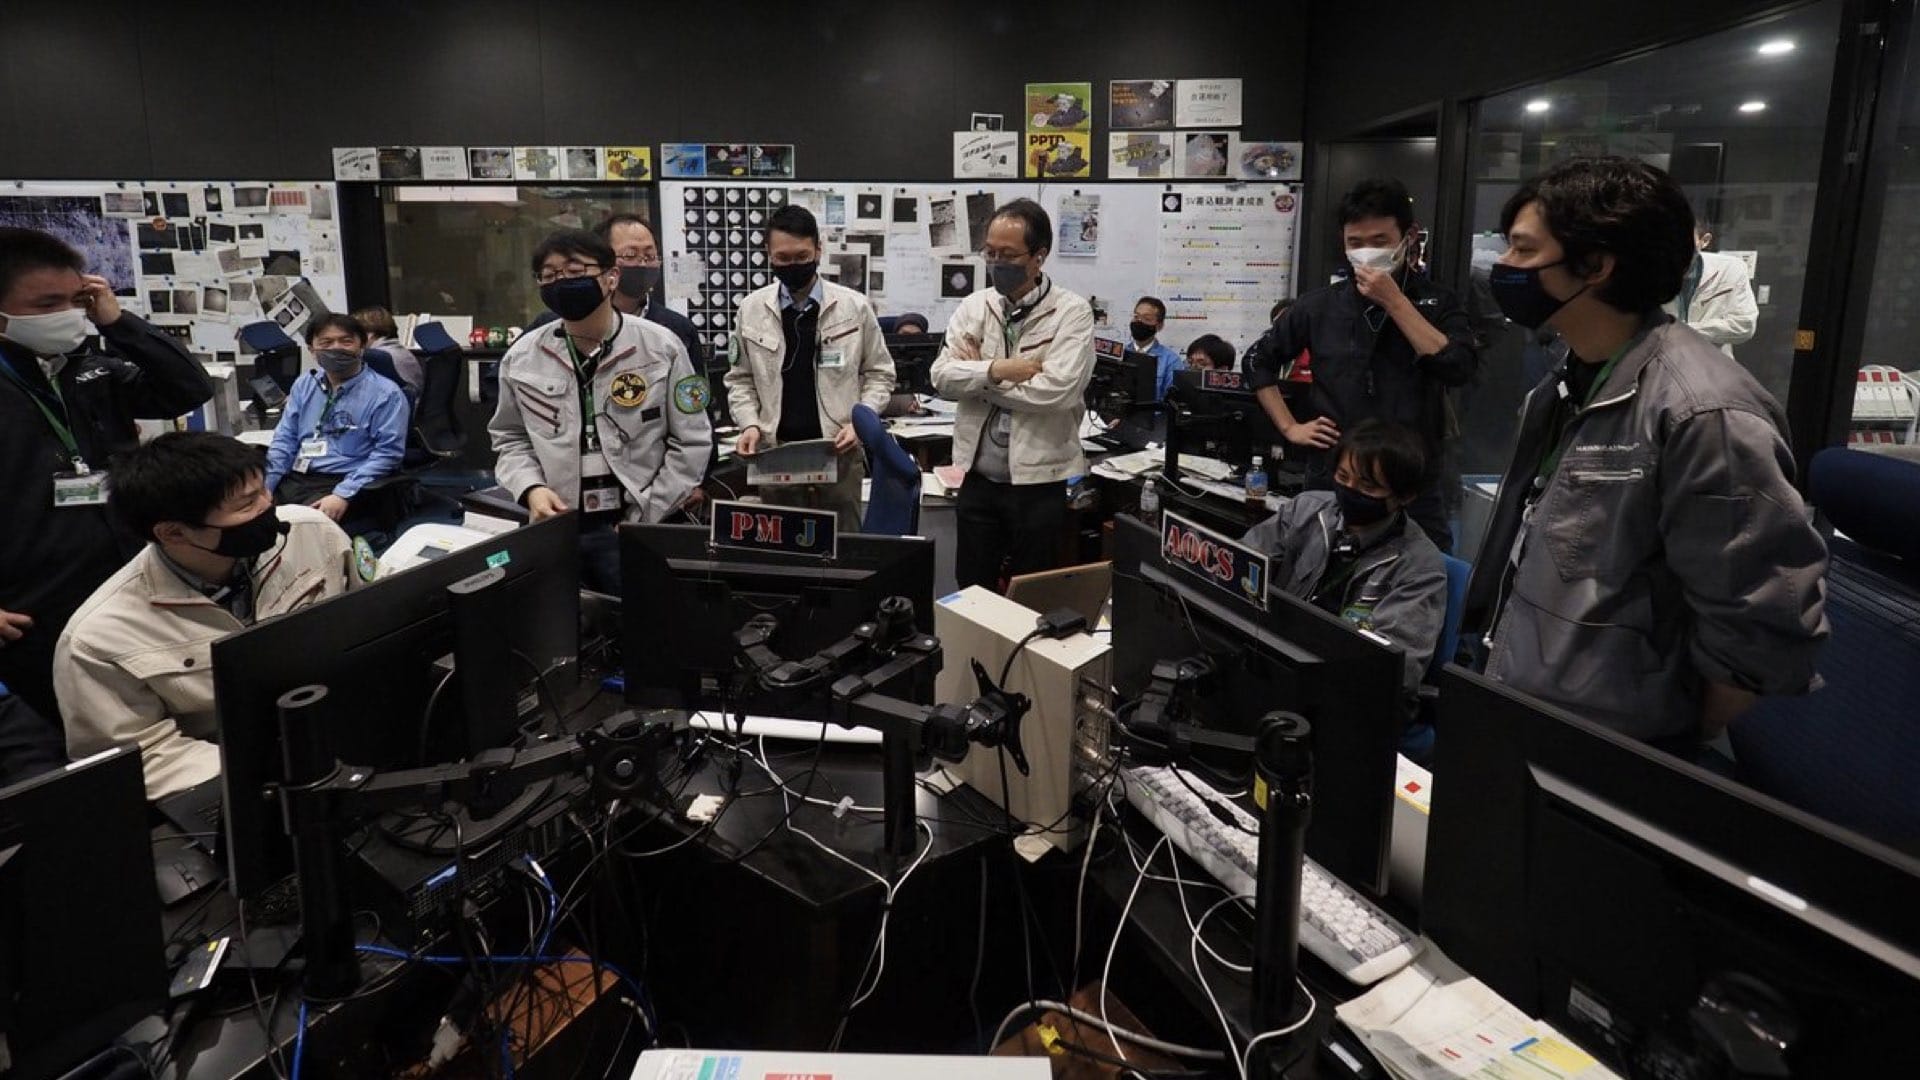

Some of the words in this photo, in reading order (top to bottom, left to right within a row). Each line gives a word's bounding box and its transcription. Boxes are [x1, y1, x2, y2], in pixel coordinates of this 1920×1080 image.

[730, 511, 783, 544] PM
[795, 518, 817, 547] J
[1167, 524, 1234, 581] AOCS
[1241, 561, 1261, 598] J
